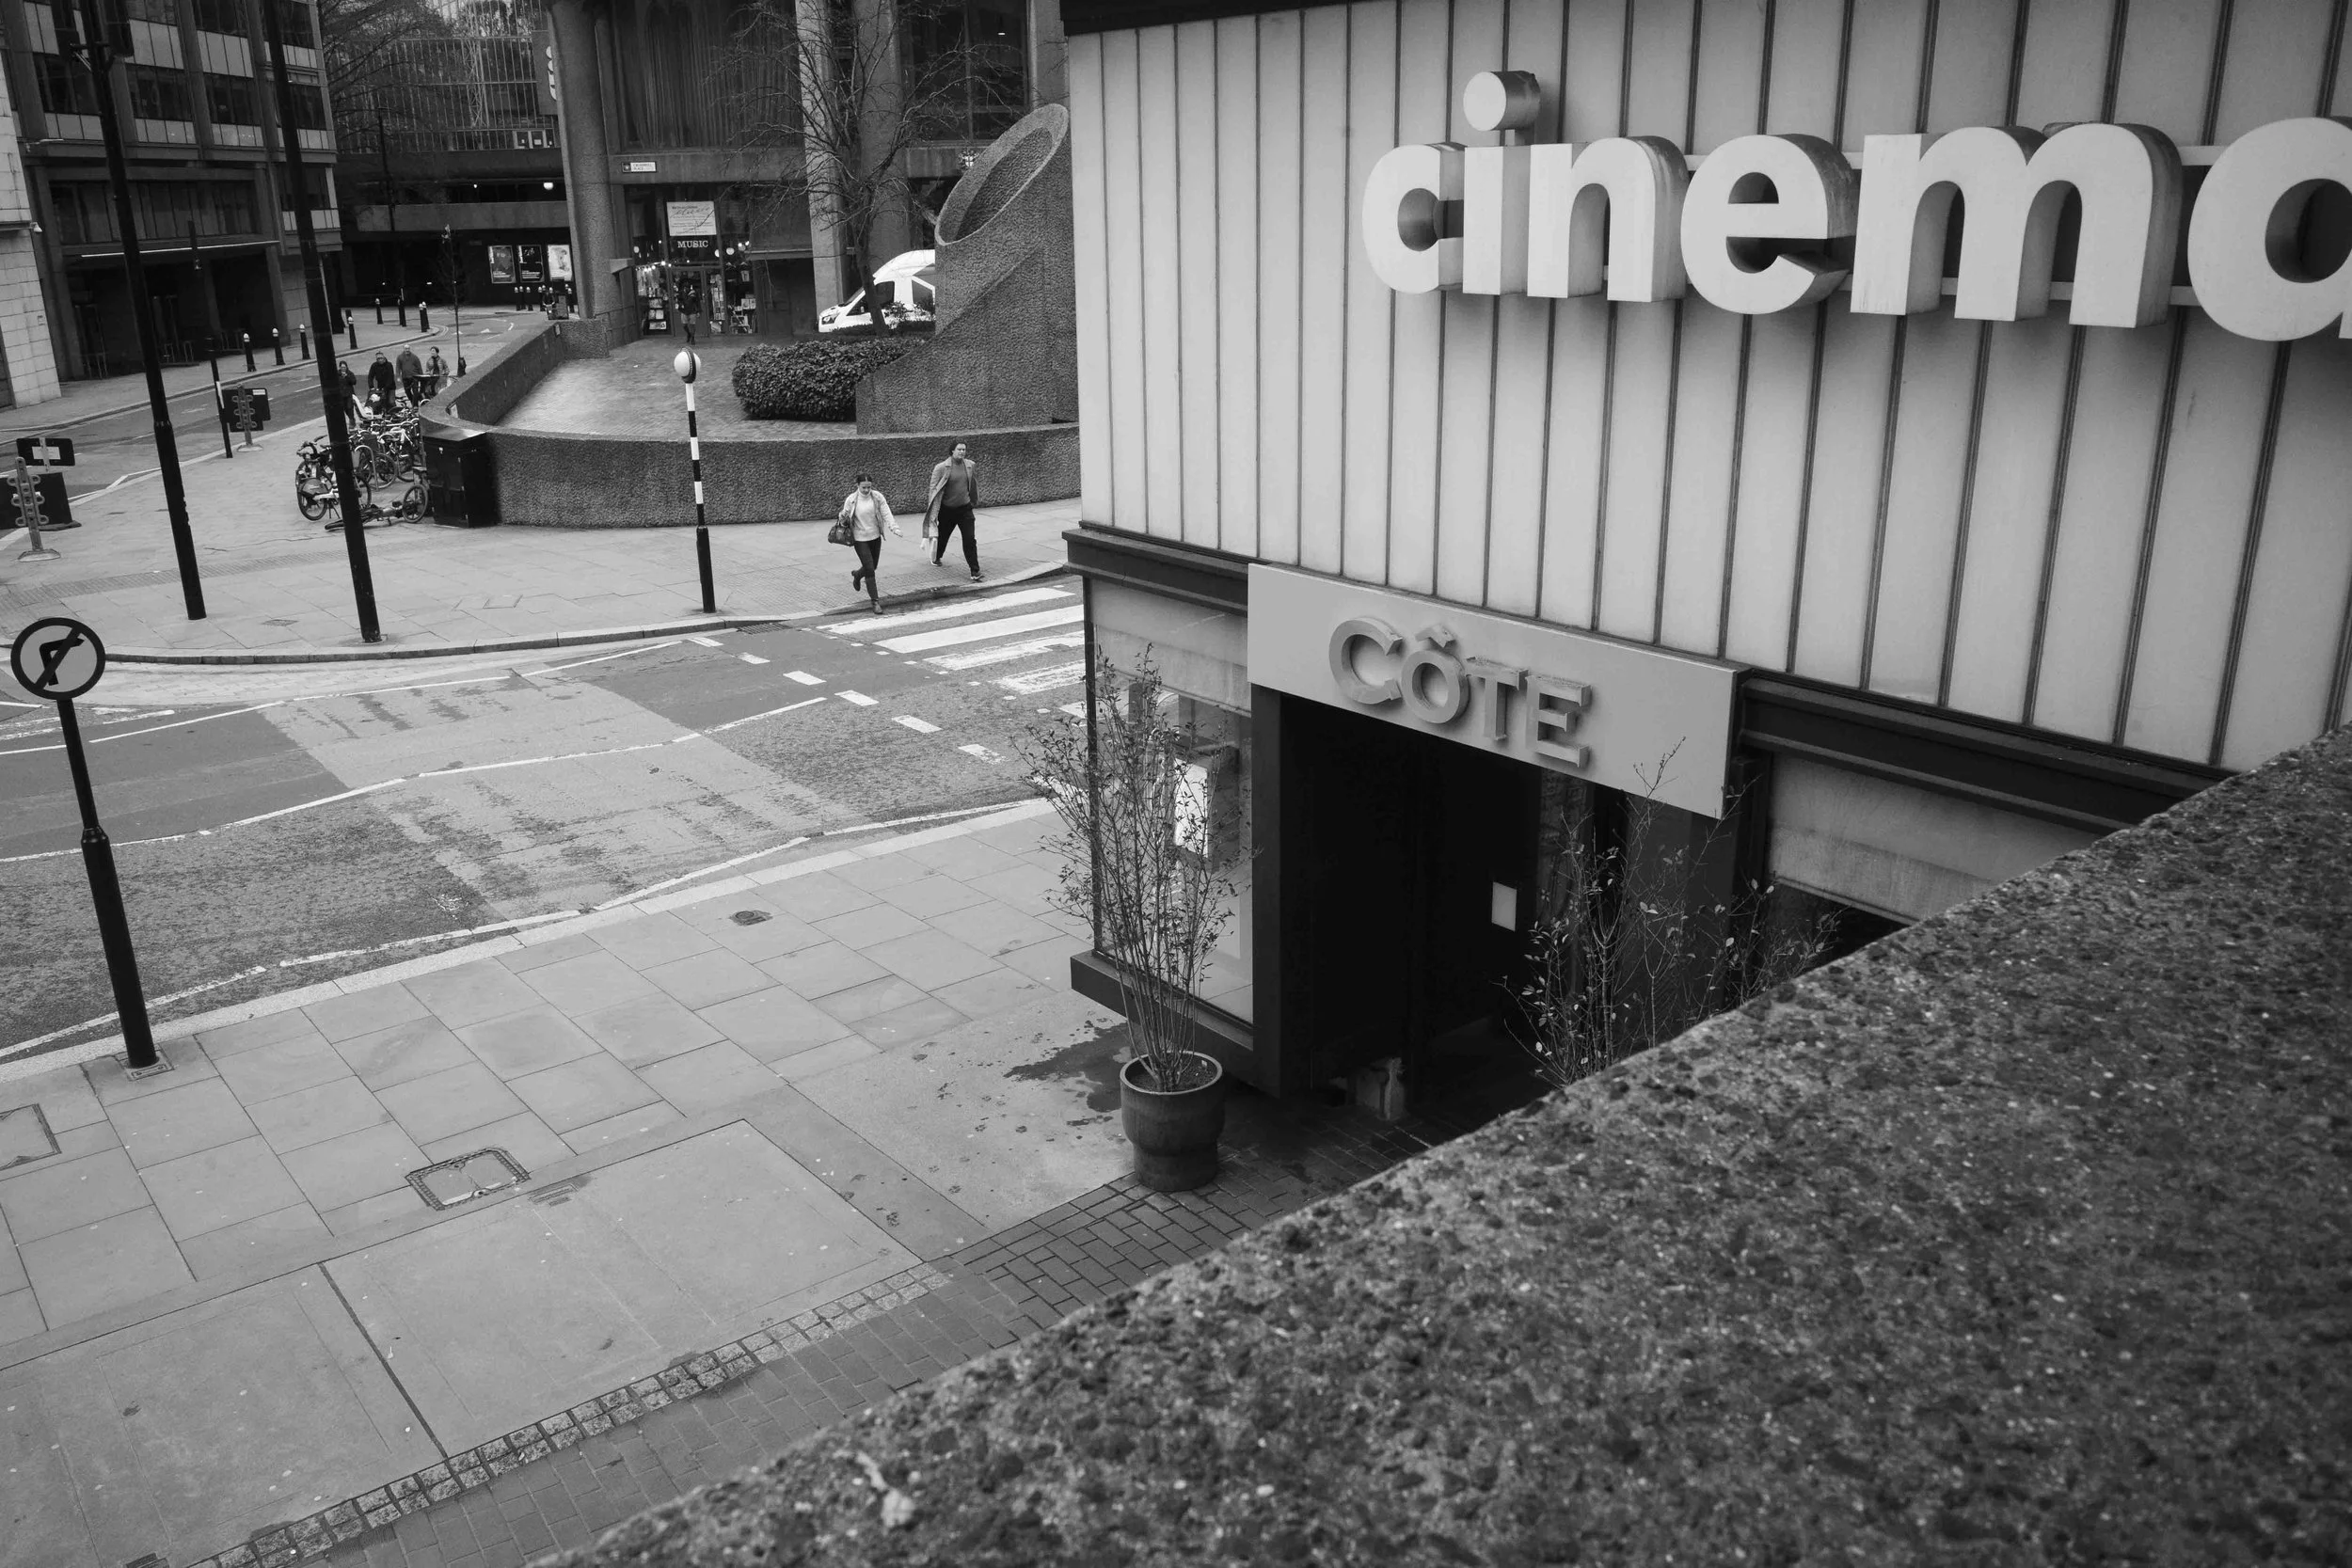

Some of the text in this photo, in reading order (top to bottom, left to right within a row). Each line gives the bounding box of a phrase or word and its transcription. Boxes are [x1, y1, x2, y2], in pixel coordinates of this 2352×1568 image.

[677, 240, 708, 248] MUSIC
[1362, 71, 2352, 341] cinema
[1328, 618, 1592, 768] CÔTE
